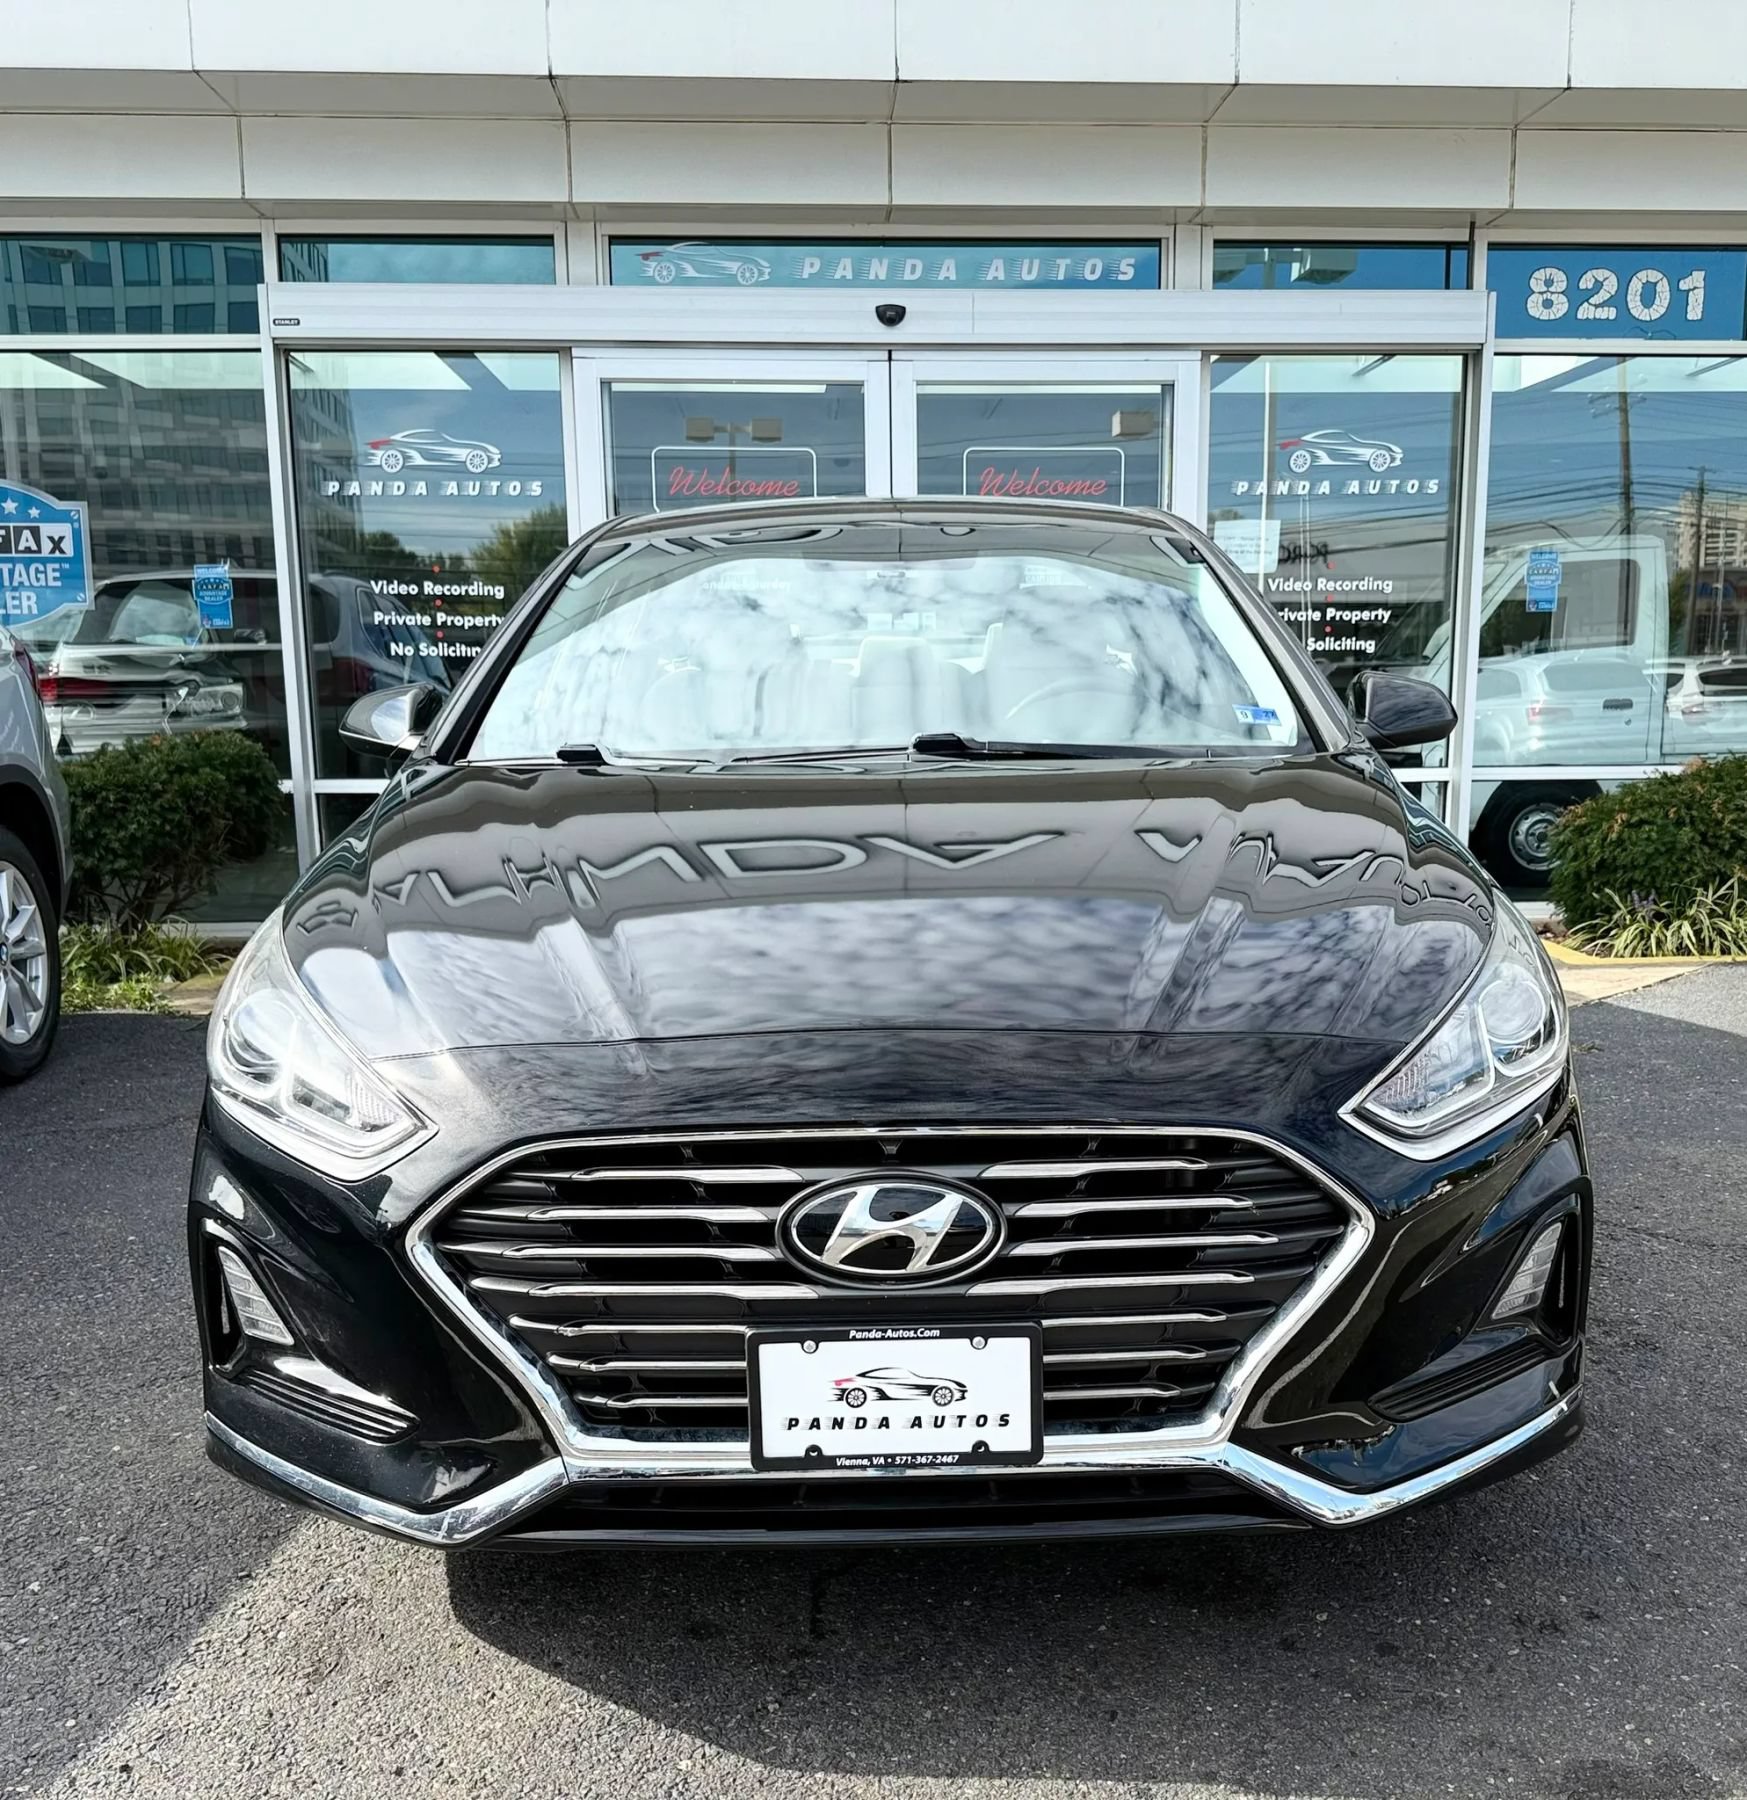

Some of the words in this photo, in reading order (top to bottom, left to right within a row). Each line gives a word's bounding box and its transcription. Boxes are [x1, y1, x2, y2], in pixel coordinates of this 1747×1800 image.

[796, 256, 957, 282] PANDA
[981, 256, 1137, 281] AUTOS
[1526, 267, 1706, 321] 8201
[322, 480, 428, 497] PANDA
[441, 480, 543, 497] AUTOS
[669, 465, 800, 498] Welcome
[978, 467, 1108, 497] Welcome
[1232, 480, 1330, 496] PANDA
[1342, 479, 1439, 495] AUTOS
[370, 580, 419, 595] Video
[423, 581, 505, 600] Recording
[1267, 578, 1313, 592] Video
[1317, 577, 1393, 593] Recording
[374, 611, 432, 627] Private
[436, 612, 505, 629] Property
[1277, 609, 1321, 622] rivate
[1326, 608, 1392, 624] Property
[390, 642, 415, 657] No
[418, 642, 482, 658] Solicitin
[1306, 637, 1376, 653] Soliciting
[848, 1327, 941, 1340] Panda-Autos.Com
[782, 1415, 892, 1431] PANDA
[903, 1413, 1011, 1430] AUTOS
[836, 1456, 872, 1467] Vienna,
[874, 1456, 886, 1466] VA
[895, 1455, 960, 1465] 571-367-2467
